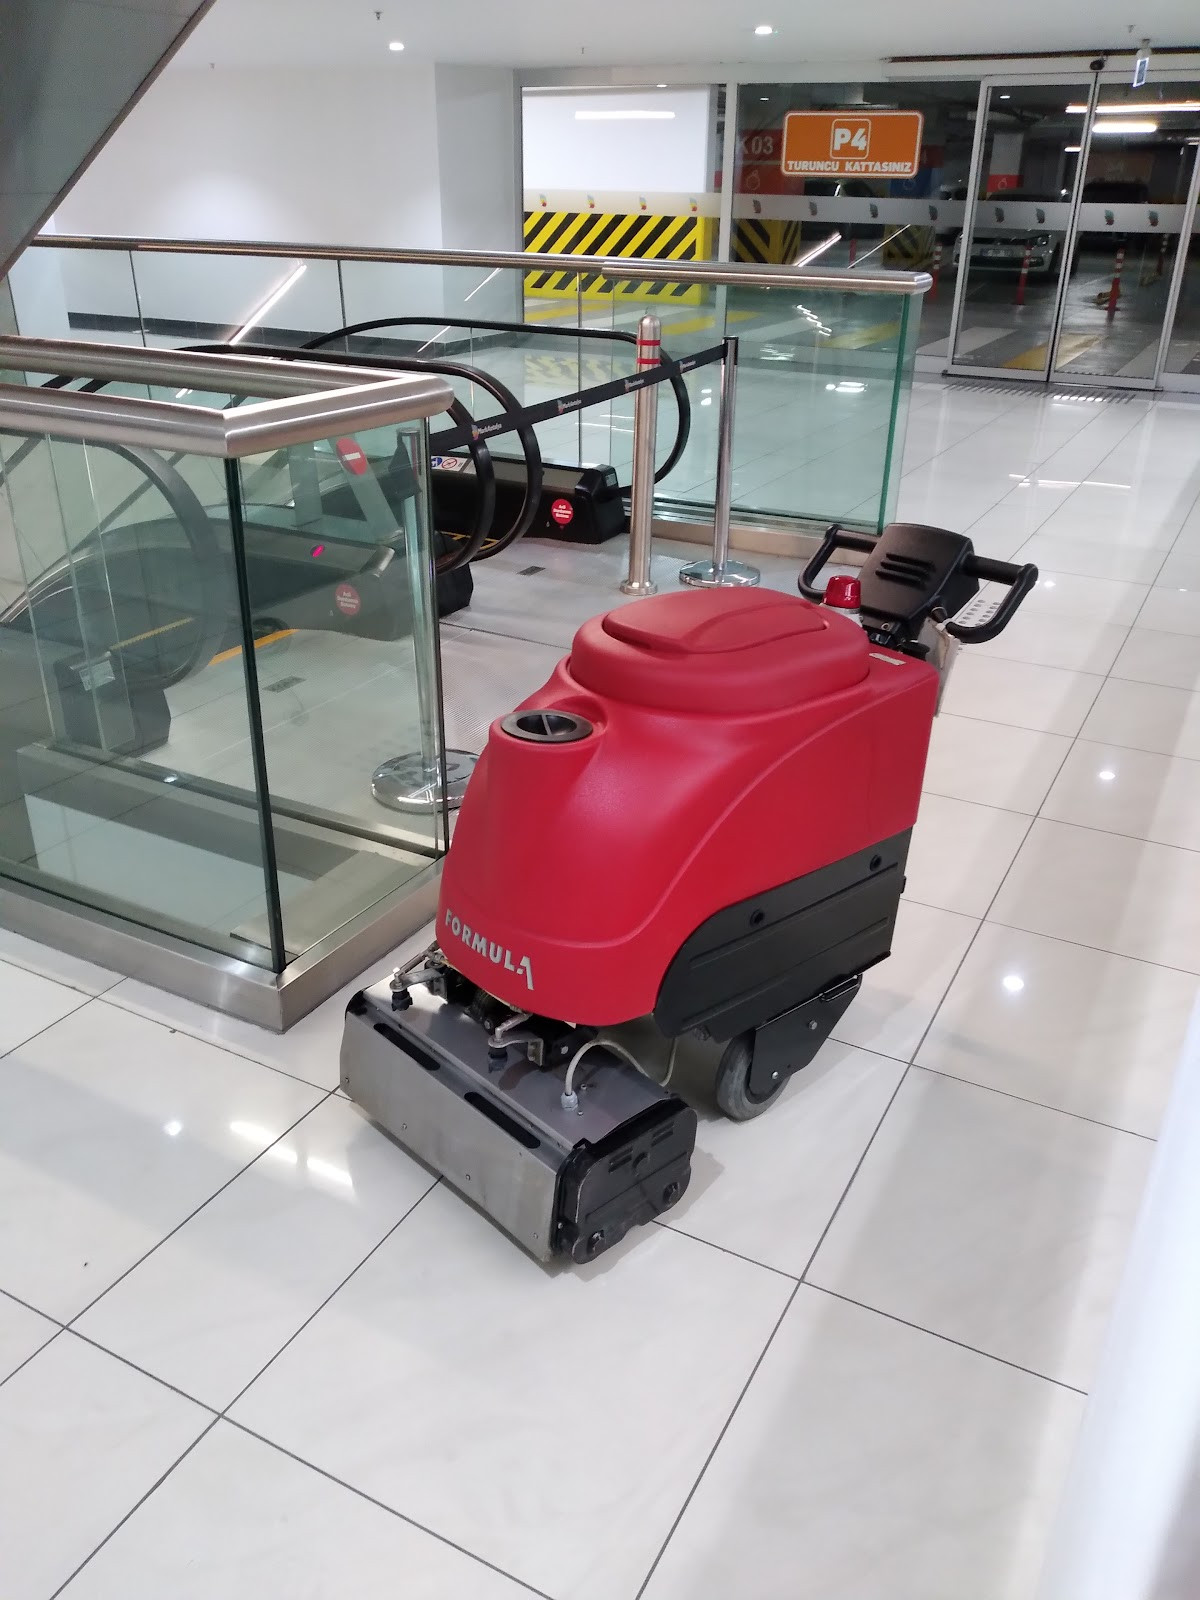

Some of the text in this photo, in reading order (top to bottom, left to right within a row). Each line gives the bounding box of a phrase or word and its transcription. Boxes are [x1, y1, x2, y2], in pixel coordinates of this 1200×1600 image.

[751, 136, 773, 155] 03
[832, 127, 867, 151] P4
[787, 160, 912, 173] TURUNCU KATTASINIZ
